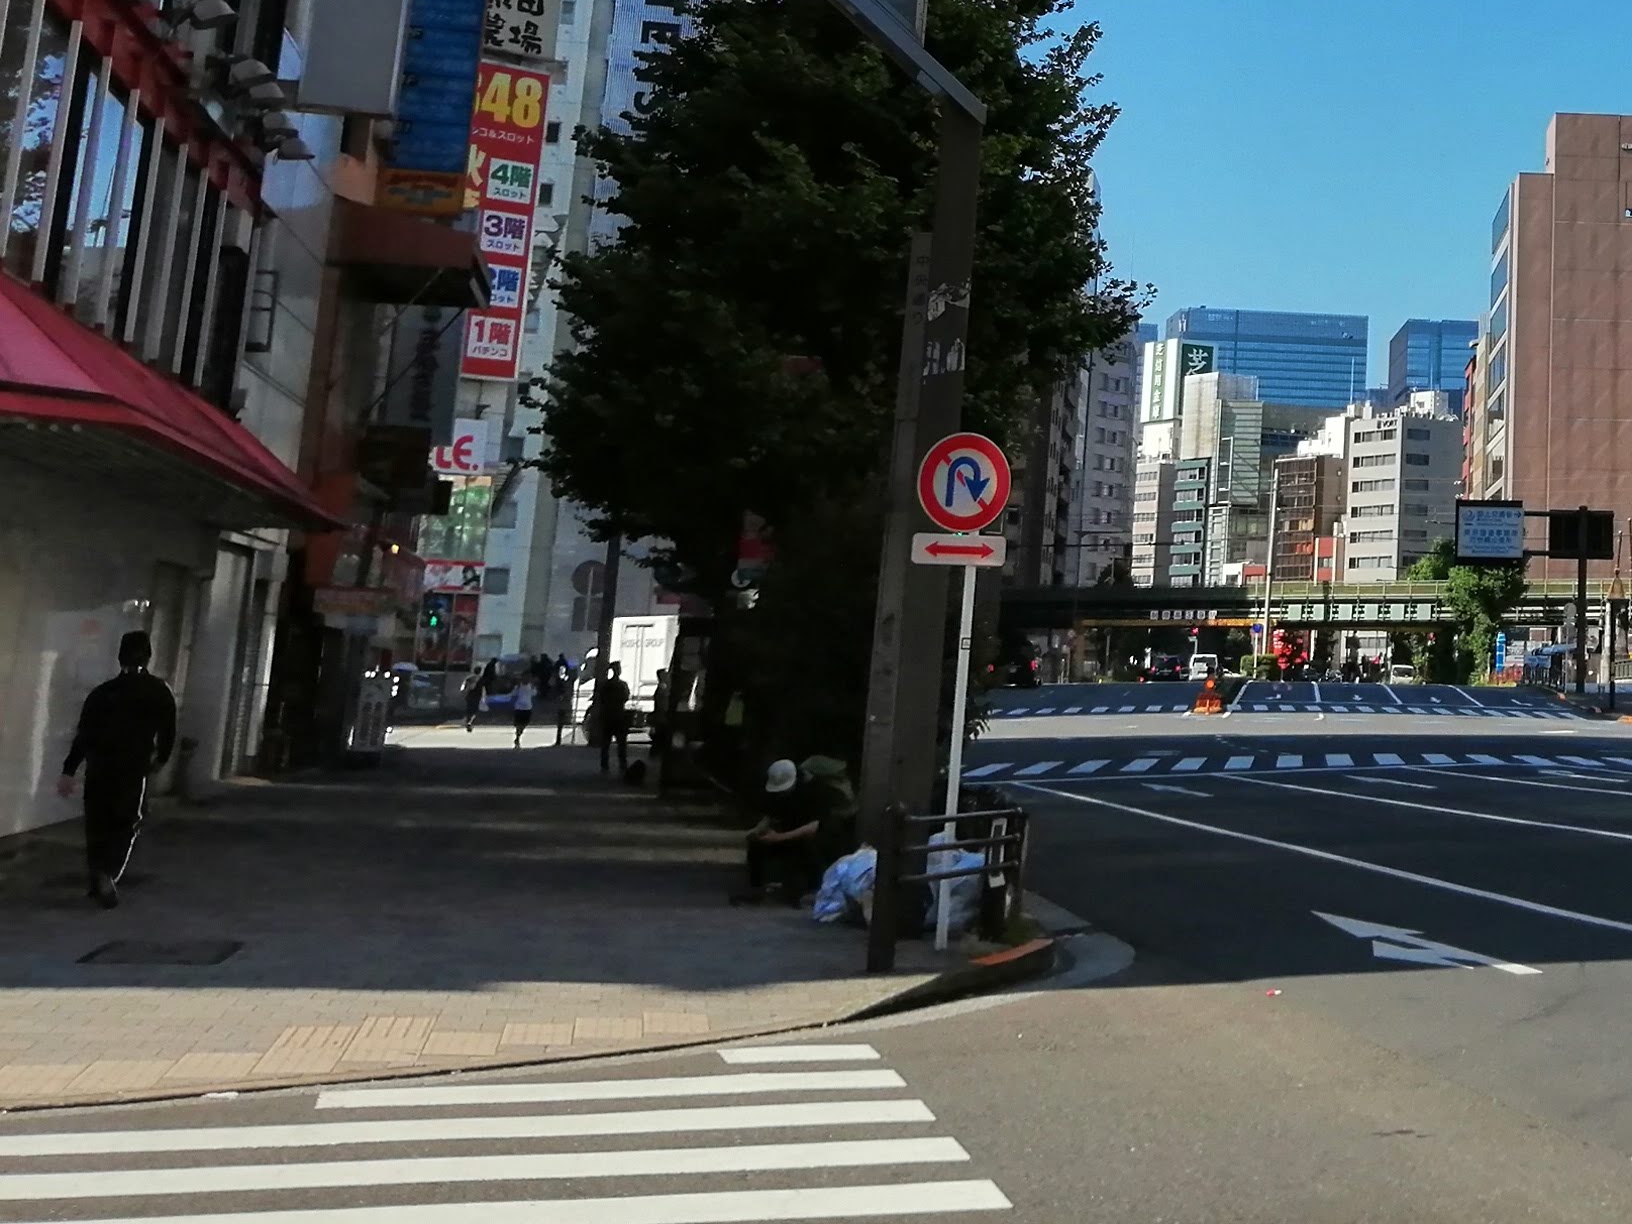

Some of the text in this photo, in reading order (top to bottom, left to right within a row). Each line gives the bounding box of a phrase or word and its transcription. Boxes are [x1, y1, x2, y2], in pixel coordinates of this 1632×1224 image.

[472, 73, 542, 128] 48
[490, 161, 532, 190] 4階
[493, 187, 527, 200] スロット
[483, 214, 527, 241] 3階
[485, 239, 521, 253] スロット
[472, 317, 512, 346] 1階
[471, 343, 510, 359] パチンコ
[1185, 347, 1210, 376] 芝
